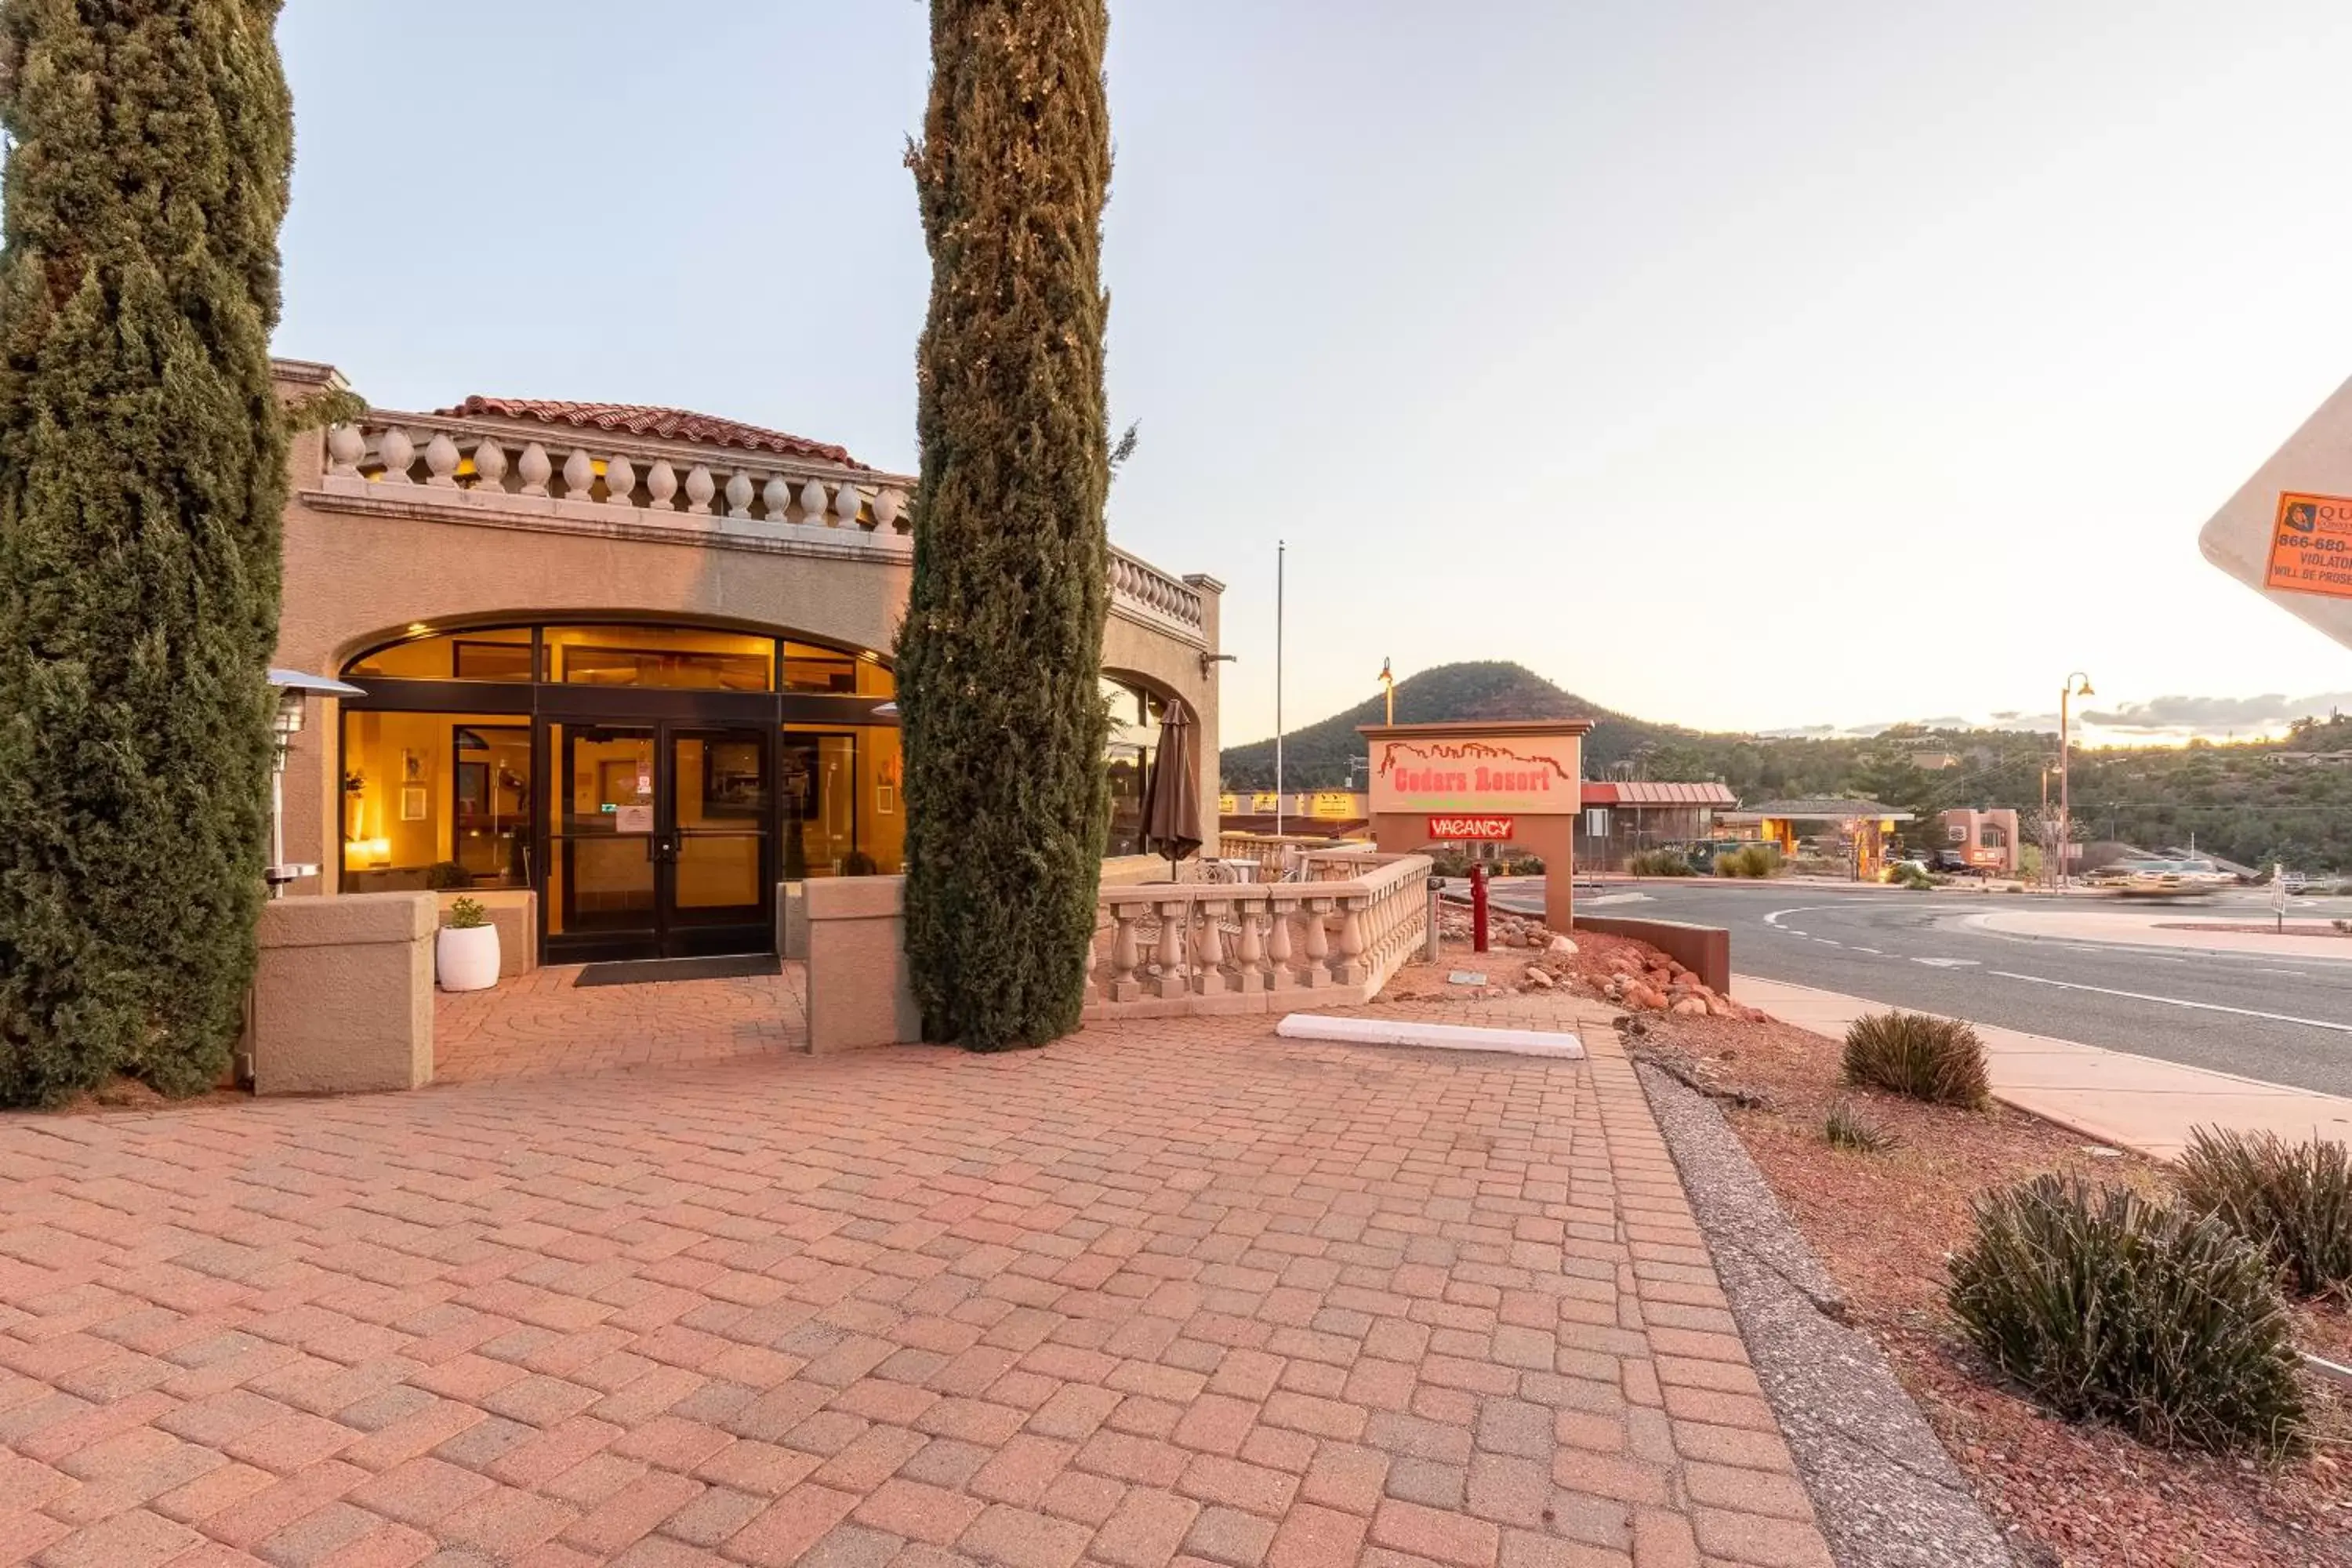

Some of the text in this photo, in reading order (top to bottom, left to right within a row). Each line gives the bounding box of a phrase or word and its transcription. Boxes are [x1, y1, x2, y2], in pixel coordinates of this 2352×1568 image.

[2274, 564, 2296, 578] WILL
[1395, 766, 1550, 792] Cedars Resort
[1431, 819, 1511, 836] VACANCY
